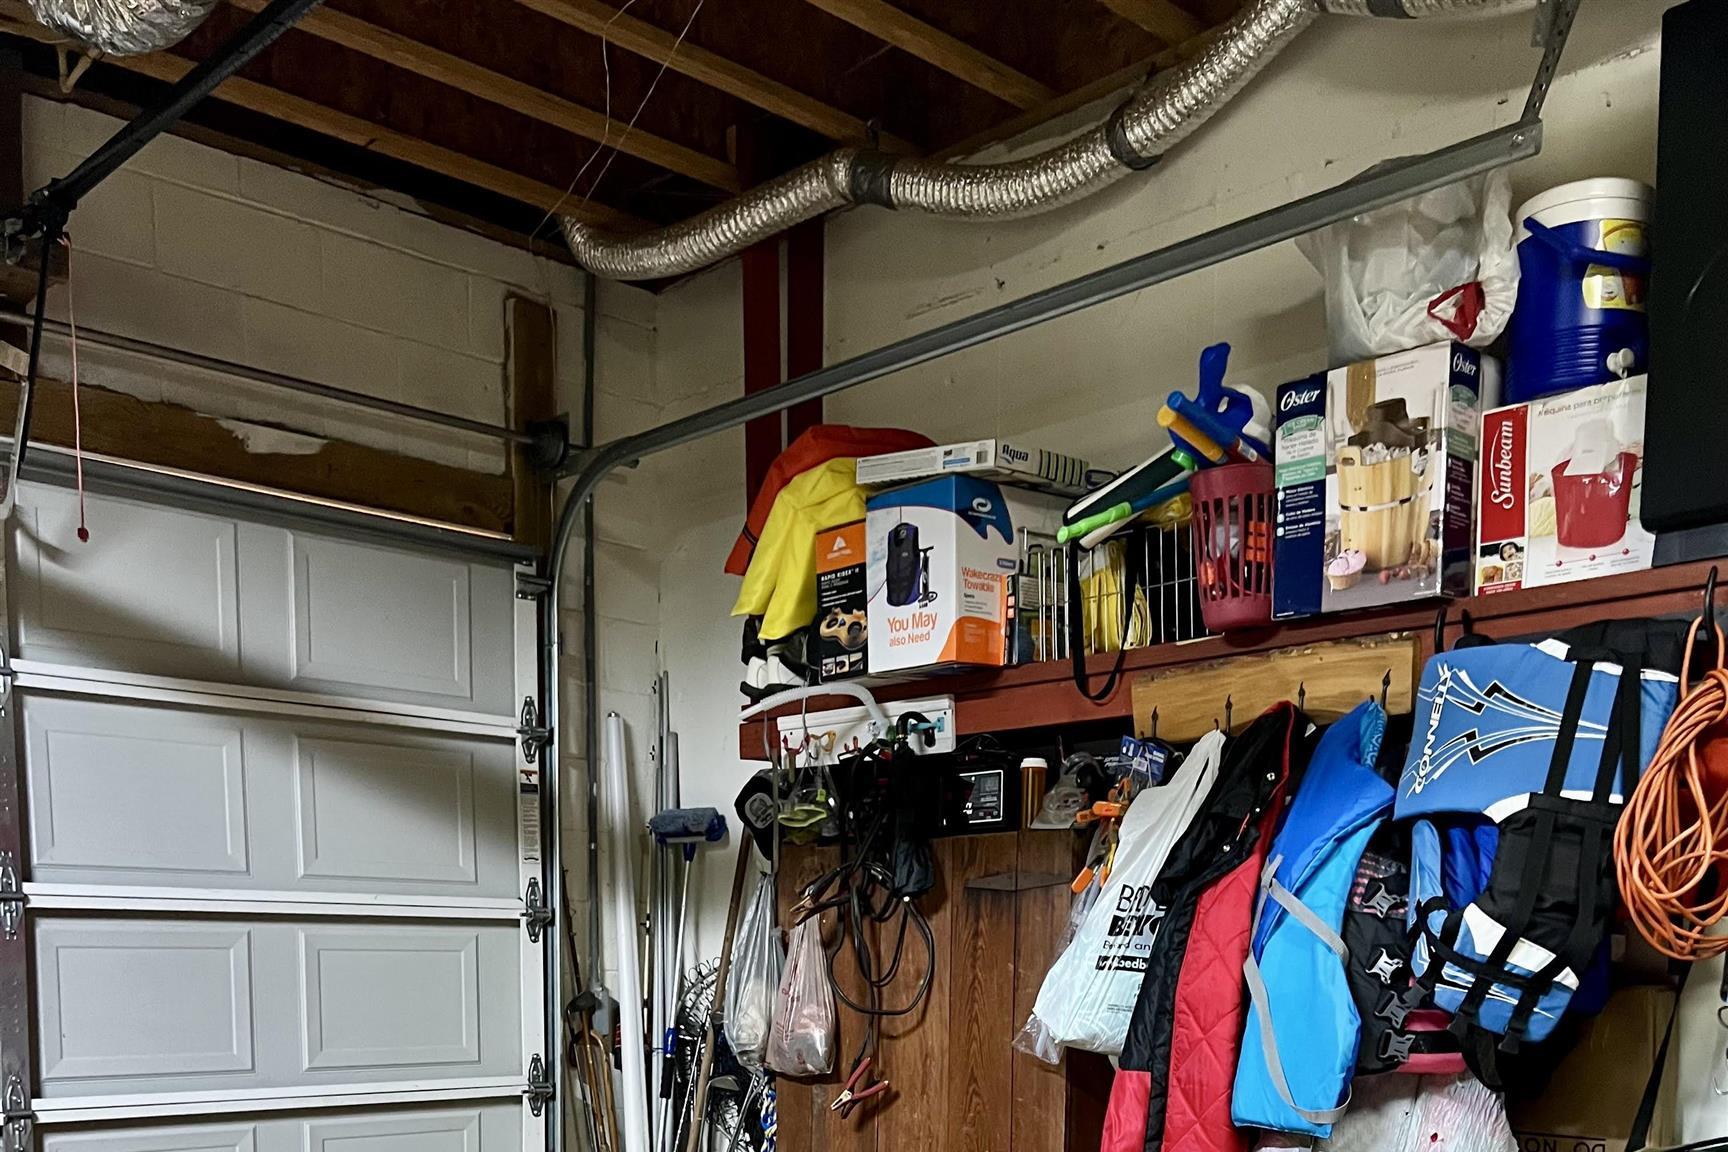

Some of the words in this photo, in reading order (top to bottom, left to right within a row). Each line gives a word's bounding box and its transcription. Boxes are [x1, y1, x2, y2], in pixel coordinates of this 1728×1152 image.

[1453, 352, 1477, 377] Oster
[1280, 389, 1321, 411] Oster
[1002, 444, 1029, 462] Aqua
[1490, 420, 1515, 510] Sunbeam
[964, 579, 994, 592] Towable
[888, 616, 910, 634] You
[911, 611, 938, 630] May
[889, 634, 906, 647] also
[907, 631, 931, 644] Need
[1414, 661, 1452, 794] CONNELLY
[1134, 942, 1151, 951] an
